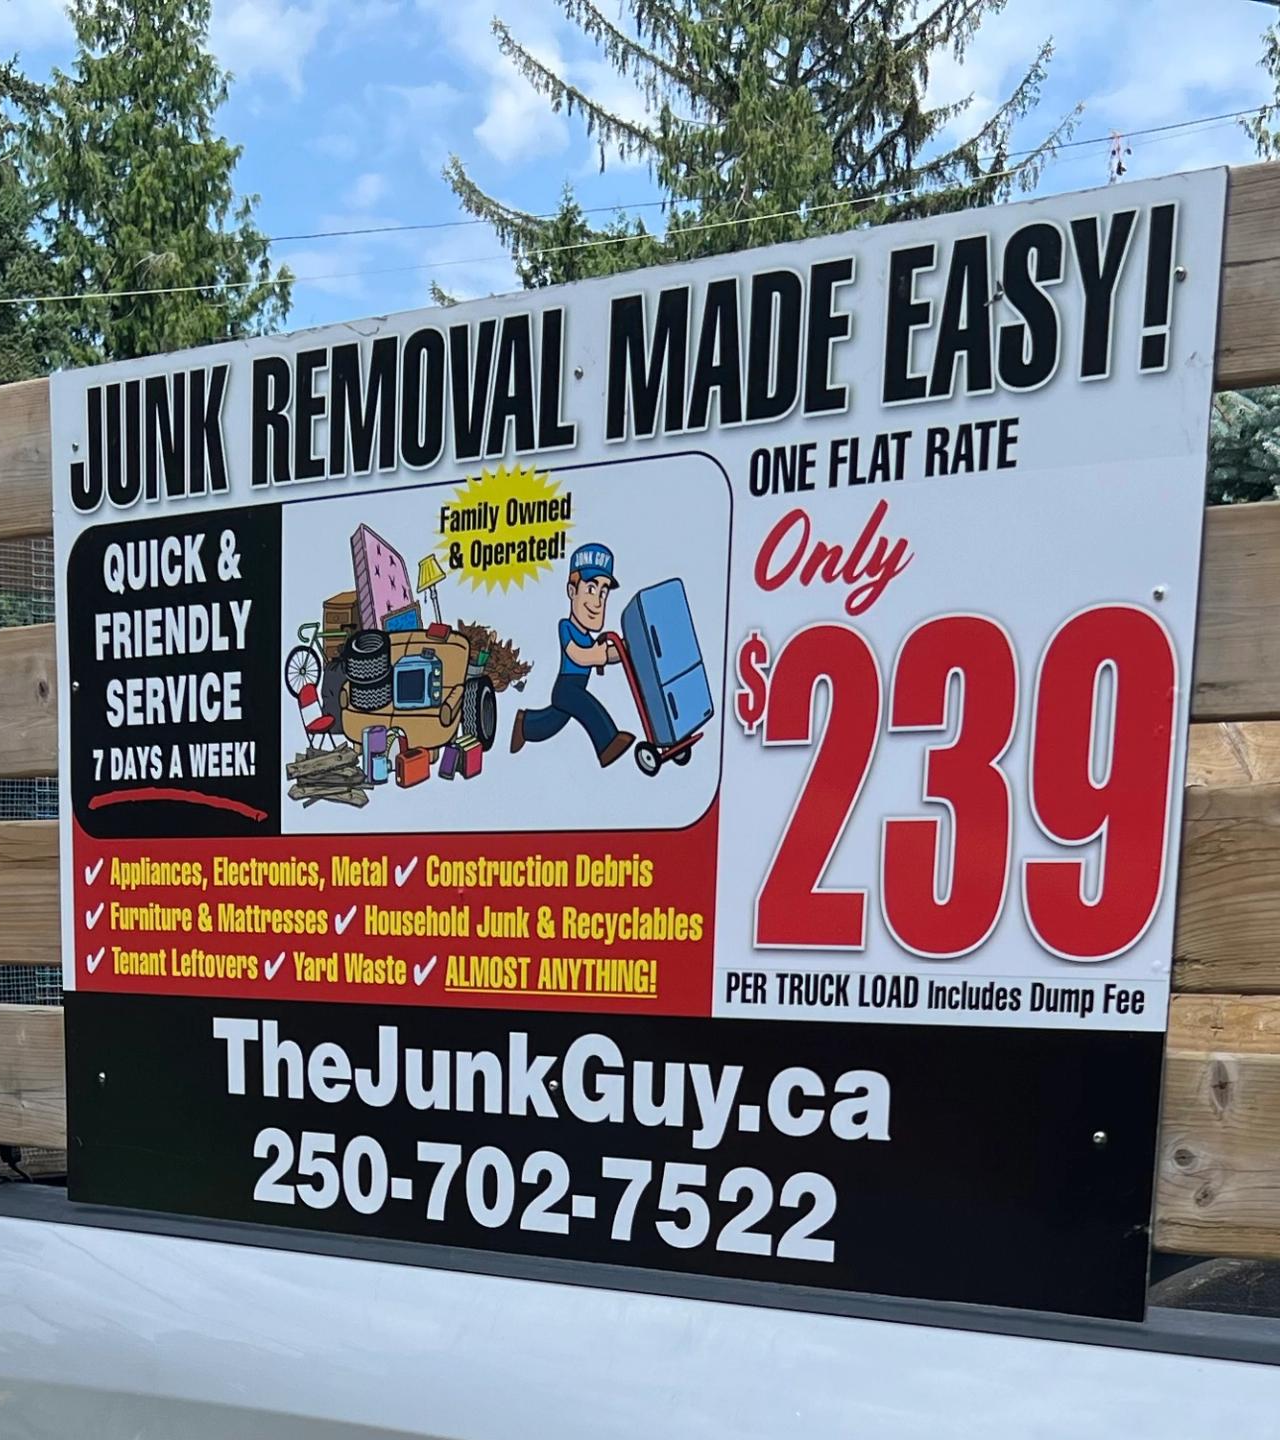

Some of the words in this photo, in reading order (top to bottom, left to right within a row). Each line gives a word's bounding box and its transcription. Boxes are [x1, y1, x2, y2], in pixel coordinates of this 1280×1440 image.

[71, 364, 229, 509] JUNK
[252, 309, 575, 485] REMOVAL
[606, 258, 854, 440] MADE
[883, 204, 1176, 403] EASY!
[749, 444, 816, 496] ONE
[830, 431, 912, 488] FLAT
[925, 418, 1019, 476] RATE
[439, 501, 499, 533] Family
[506, 492, 572, 526] Owned
[103, 533, 206, 595] QUICK
[219, 529, 242, 581] &
[449, 542, 464, 569] &
[470, 531, 566, 571] Operated!
[575, 551, 593, 567] JUNK
[754, 499, 915, 616] Only
[95, 600, 251, 660] FRIENDLY
[106, 672, 242, 729] SERVICE
[93, 749, 104, 780] 7
[111, 745, 162, 780] DAYS
[168, 745, 183, 777] A
[189, 740, 256, 776] WEEK!
[736, 605, 1175, 960] $239
[110, 858, 208, 892] Appliances,
[213, 856, 326, 892] Electronics,
[332, 855, 388, 887] Metal
[426, 855, 568, 888] Construction
[575, 853, 653, 888] Debris
[110, 902, 193, 932] Furniture
[198, 905, 212, 933] &
[218, 905, 328, 935] Mattresses
[364, 905, 469, 938] Household
[476, 907, 529, 939] Junk
[536, 907, 555, 940] &
[562, 907, 703, 946] Recyclables
[111, 946, 167, 976] Tenant
[172, 948, 258, 979] Leftovers
[292, 950, 338, 983] Yard
[344, 952, 407, 985] Waste
[446, 955, 530, 990] ALMOST
[537, 957, 657, 993] ANYTHING!
[726, 973, 767, 1006] PER
[776, 972, 850, 1008] TRUCK
[858, 975, 920, 1010] LOAD
[927, 979, 1021, 1011] Includes
[1029, 982, 1094, 1018] Dump
[1102, 983, 1145, 1015] Fee
[213, 1017, 892, 1150] TheJunkGuy.ca
[253, 1127, 837, 1262] 250-702-7522
